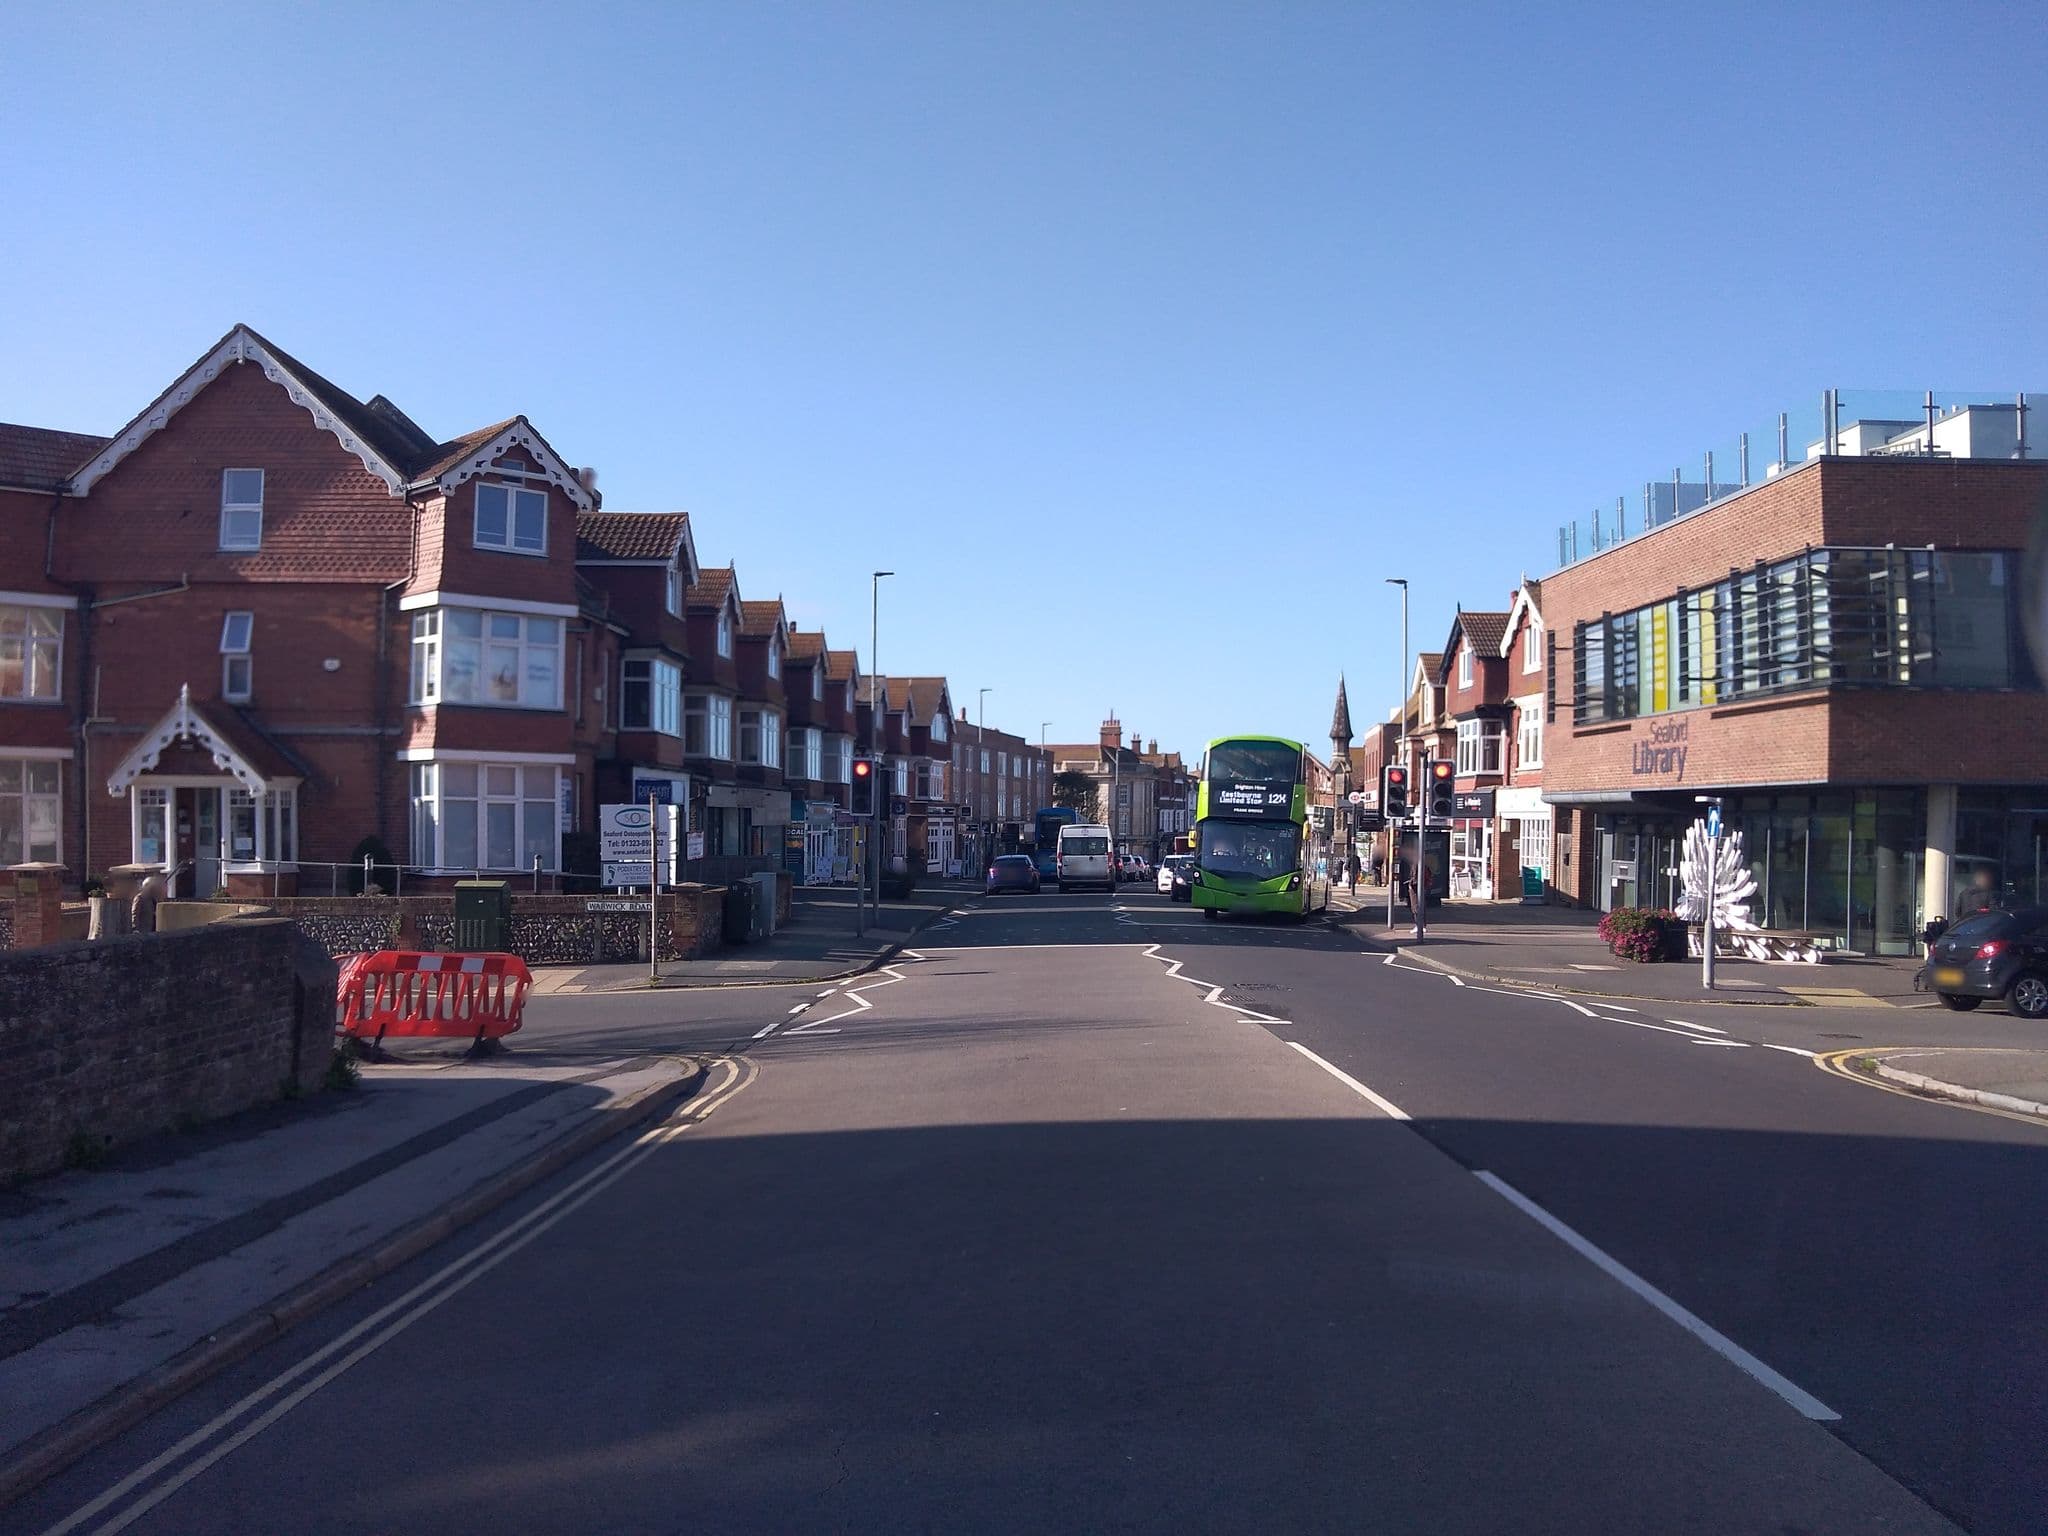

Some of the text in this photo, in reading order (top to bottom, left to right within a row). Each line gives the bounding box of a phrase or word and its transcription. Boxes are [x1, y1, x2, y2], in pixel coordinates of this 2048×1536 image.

[1650, 715, 1688, 745] Seaford
[1632, 739, 1688, 782] Library
[1221, 790, 1262, 798] Eastbourne
[1268, 793, 1287, 804] 12X
[589, 903, 653, 911] WARWICK ROAD
